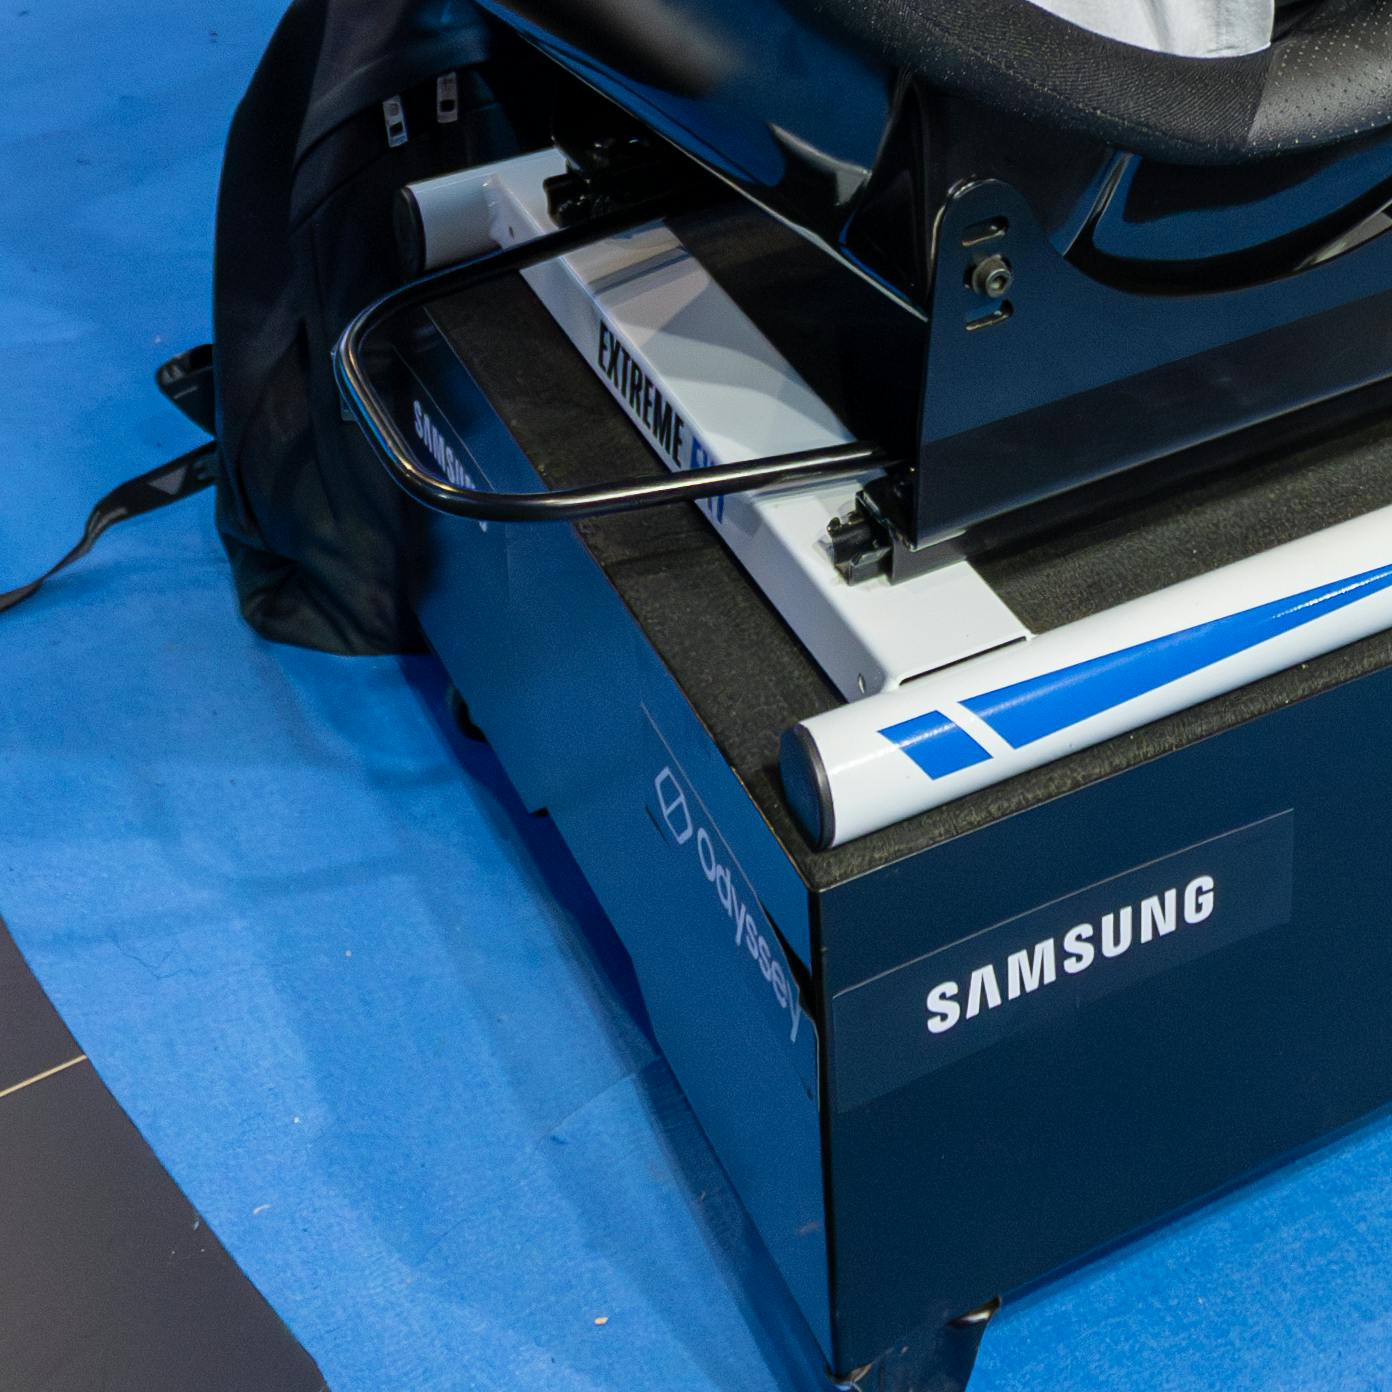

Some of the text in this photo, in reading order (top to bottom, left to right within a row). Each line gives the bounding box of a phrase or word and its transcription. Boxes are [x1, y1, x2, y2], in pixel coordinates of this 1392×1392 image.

[598, 318, 685, 470] EXTREME
[697, 826, 801, 1044] Odyssey
[926, 875, 1215, 1034] SAMSUNG
